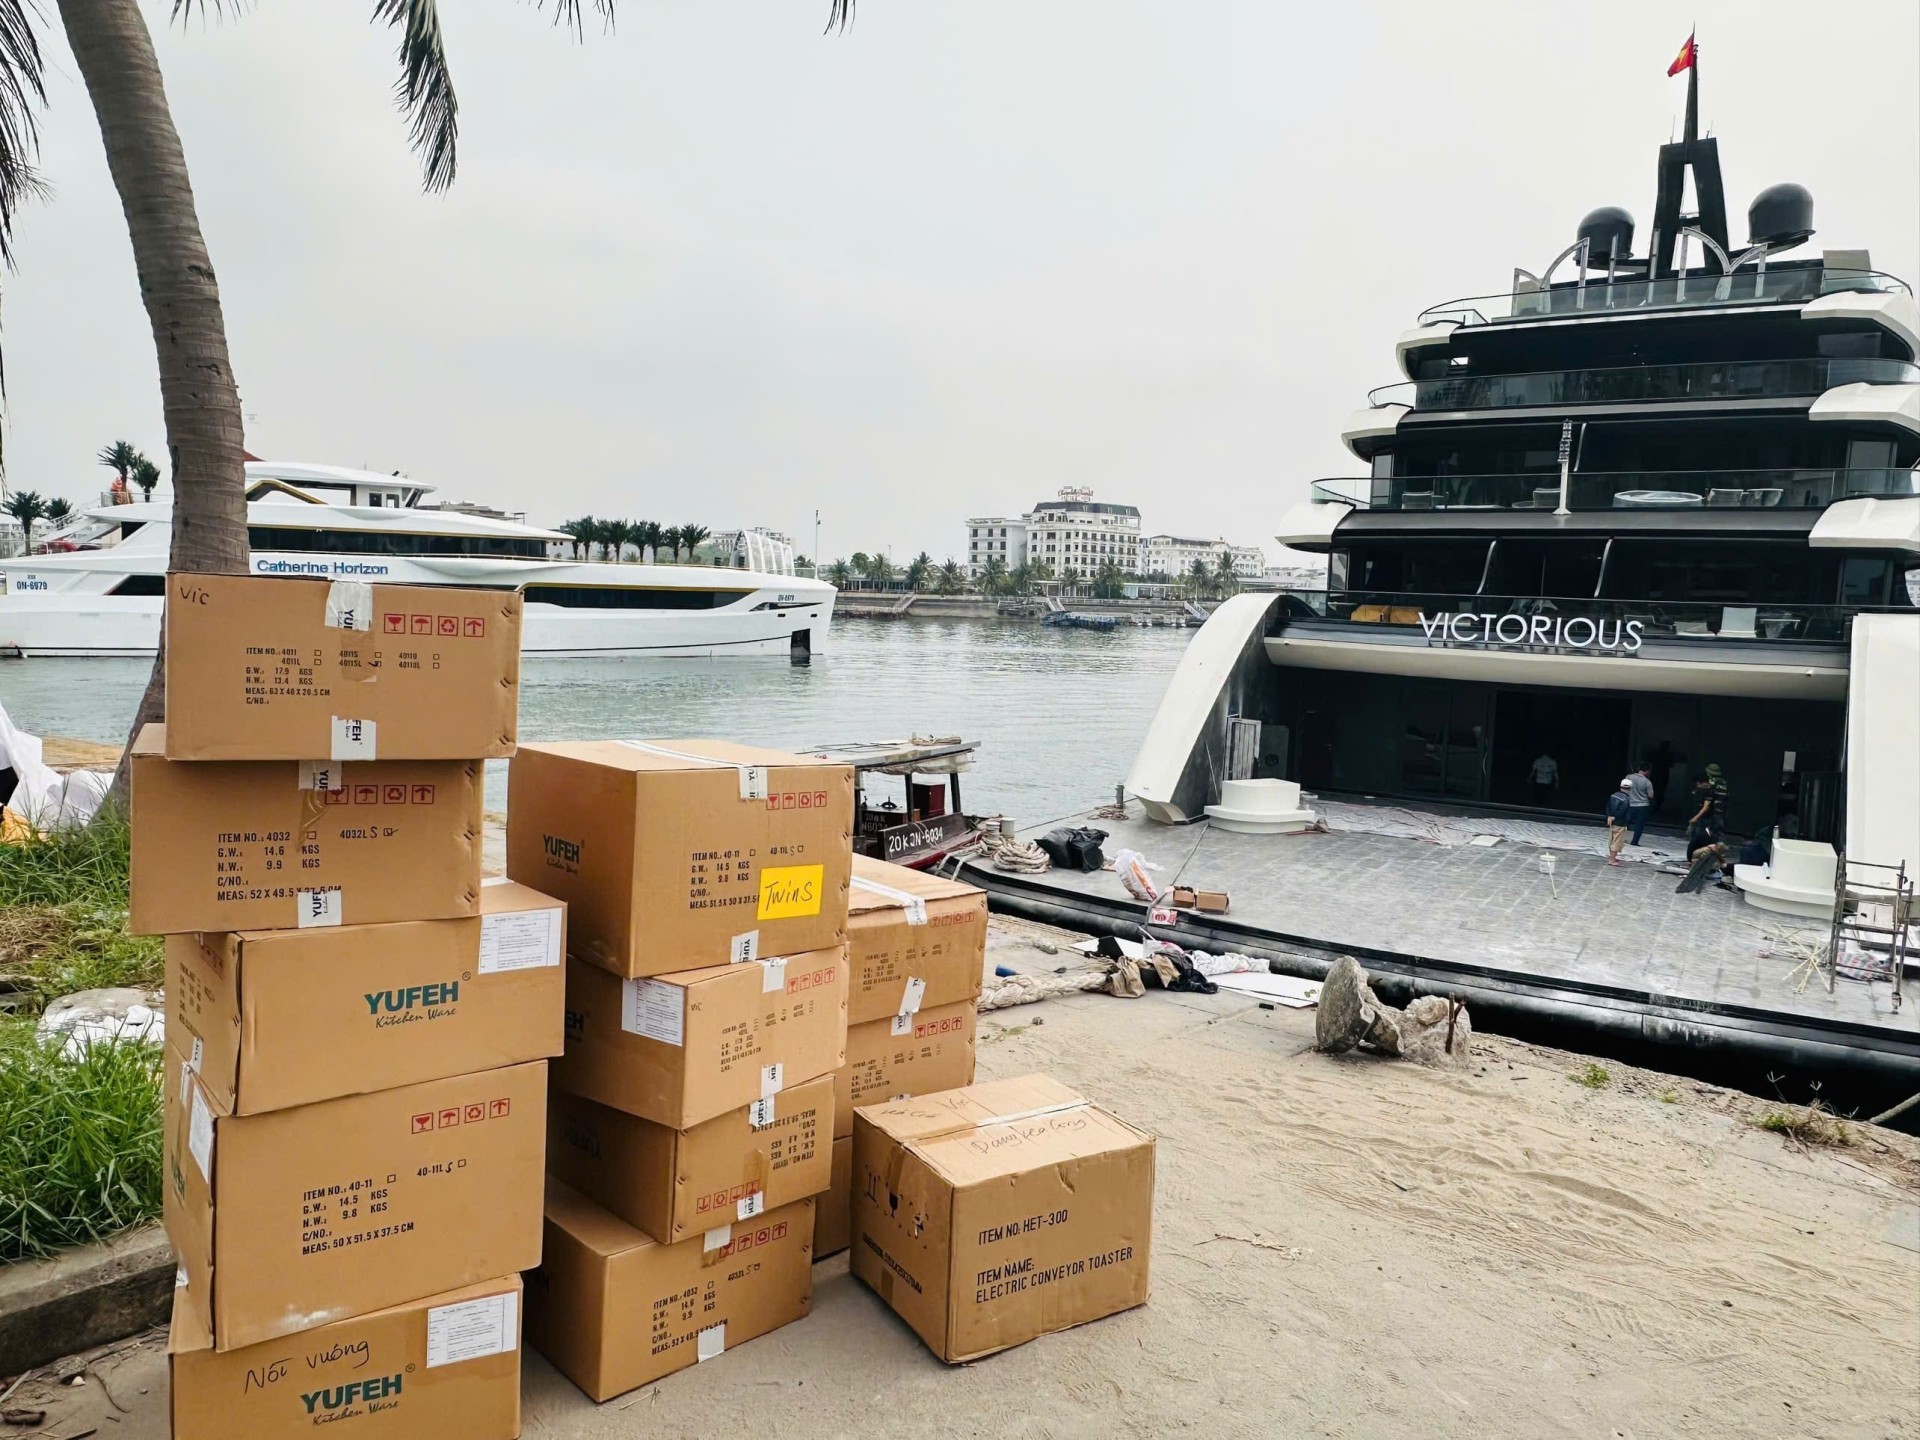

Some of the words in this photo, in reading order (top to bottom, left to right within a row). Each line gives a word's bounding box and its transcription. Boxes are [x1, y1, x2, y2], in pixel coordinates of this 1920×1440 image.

[257, 558, 329, 574] Catherine
[333, 561, 388, 575] Horizon
[1419, 612, 1643, 650] VICTORIOUS
[246, 647, 264, 655] ITEM
[281, 648, 297, 656] 4011
[281, 657, 301, 665] 4011L
[299, 668, 313, 676] KGS
[218, 833, 241, 842] ITEM
[266, 831, 290, 841] 4032
[340, 829, 367, 839] 4032L
[264, 846, 284, 856] 14.6
[301, 844, 320, 854] KGS
[543, 834, 579, 864] YUFEH
[692, 852, 707, 861] ITEM
[266, 860, 282, 870] 9.9
[302, 859, 320, 868] KGS
[738, 861, 750, 869] KGS
[737, 873, 749, 881] KGS
[250, 889, 262, 899] 52
[264, 889, 270, 898] X
[273, 888, 294, 898] 49.5
[364, 980, 459, 1015] YUFEH
[375, 1011, 423, 1028] Kitchen
[428, 1007, 456, 1021] Ware
[303, 1188, 325, 1202] ITEM
[349, 1178, 373, 1191] 40-11
[339, 1195, 358, 1208] 14.5
[370, 1188, 388, 1201] KGS
[342, 1208, 357, 1220] 9.8
[370, 1202, 388, 1214] KGS
[333, 1238, 344, 1249] 50
[346, 1236, 352, 1246] X
[373, 1229, 380, 1240] X
[381, 1225, 399, 1237] 37.5
[401, 1222, 414, 1233] CM
[979, 1227, 1003, 1245] ITEM
[1006, 1222, 1021, 1238] NO:
[1023, 1209, 1068, 1233] HET-300
[976, 1277, 1027, 1304] ELECTRIC
[1031, 1260, 1085, 1287] CONVEYOR
[1088, 1246, 1133, 1271] TOASTER
[977, 1267, 1001, 1286] ITEM
[1004, 1258, 1035, 1278] NAME:
[654, 1298, 668, 1310] ITEM
[300, 1373, 402, 1414] YUFEH
[312, 1407, 363, 1426] Kitchen
[368, 1400, 398, 1415] Ware
